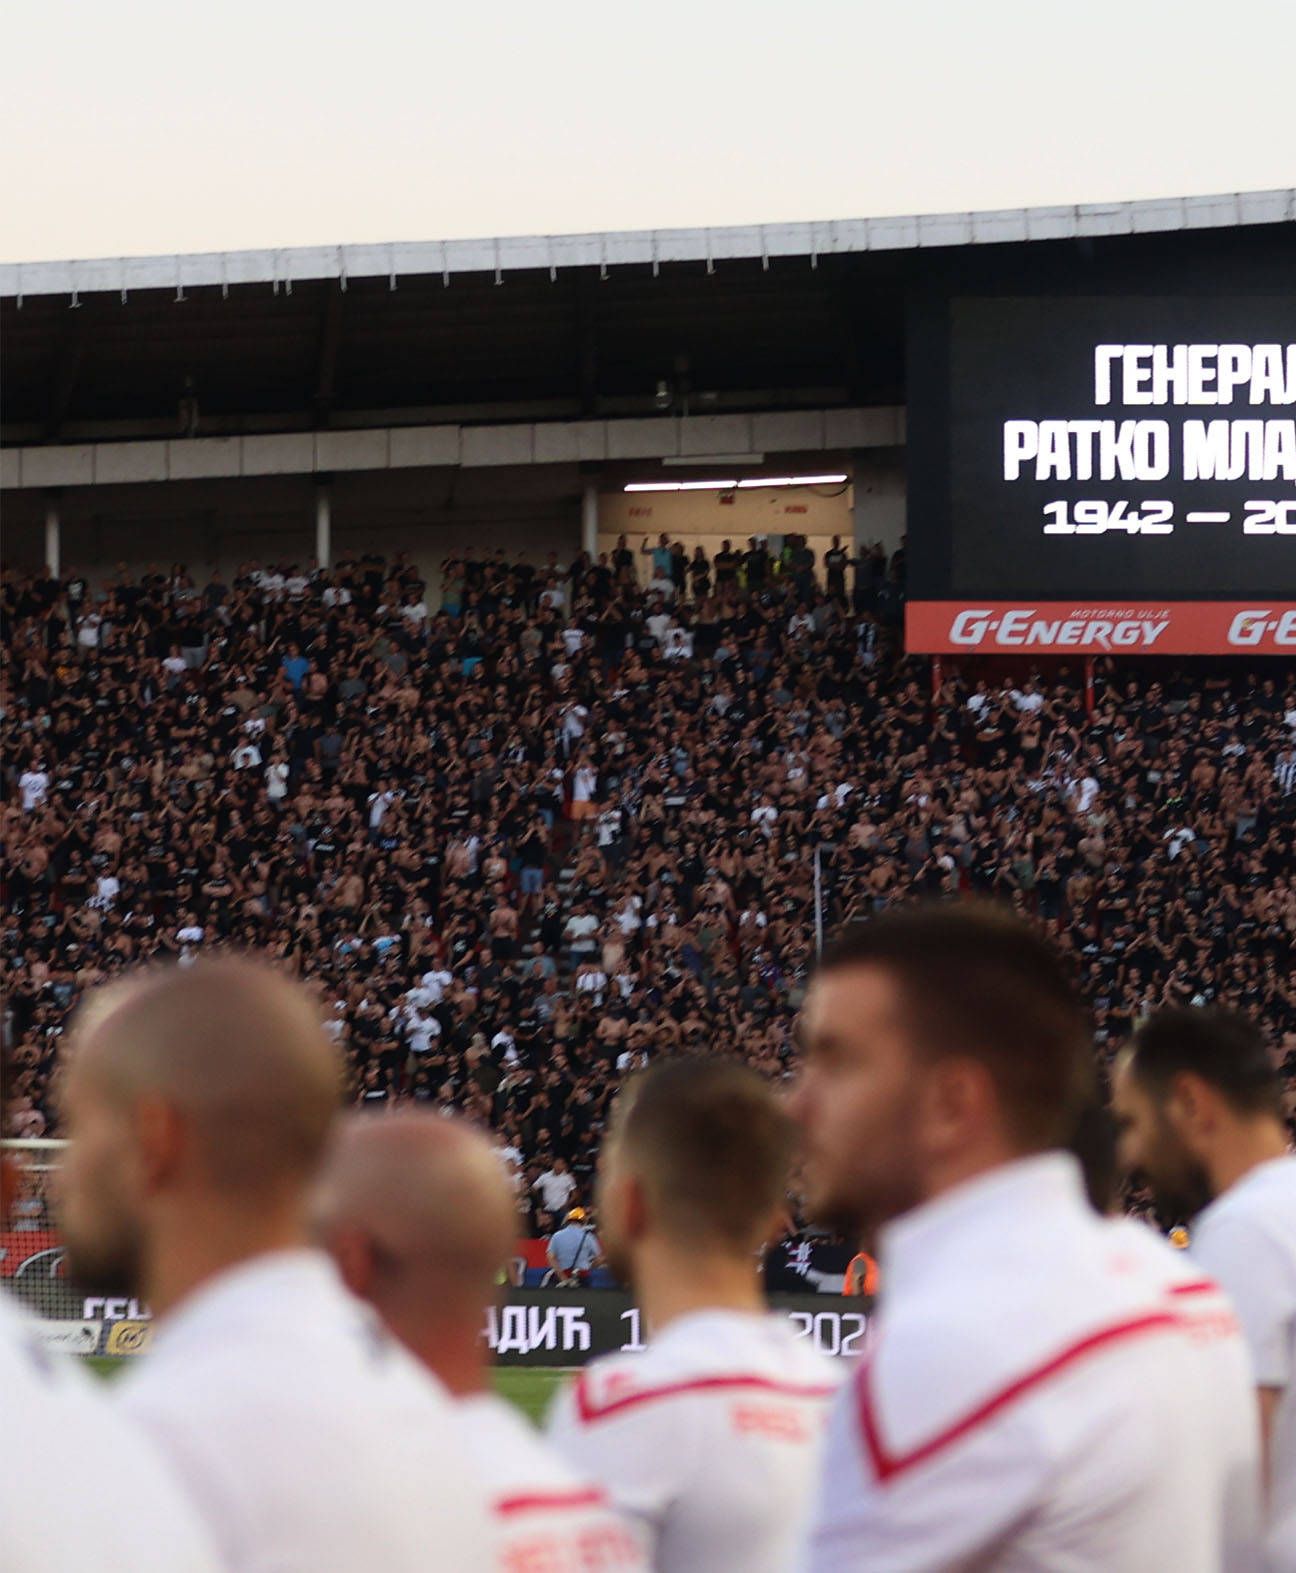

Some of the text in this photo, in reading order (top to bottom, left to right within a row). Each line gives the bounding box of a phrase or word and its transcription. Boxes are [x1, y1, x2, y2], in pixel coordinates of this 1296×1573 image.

[1003, 419, 1170, 481] РАТКО
[1043, 500, 1174, 535] 1942
[1070, 608, 1171, 620] MOTORNO ULJE
[787, 1311, 873, 1357] 202
